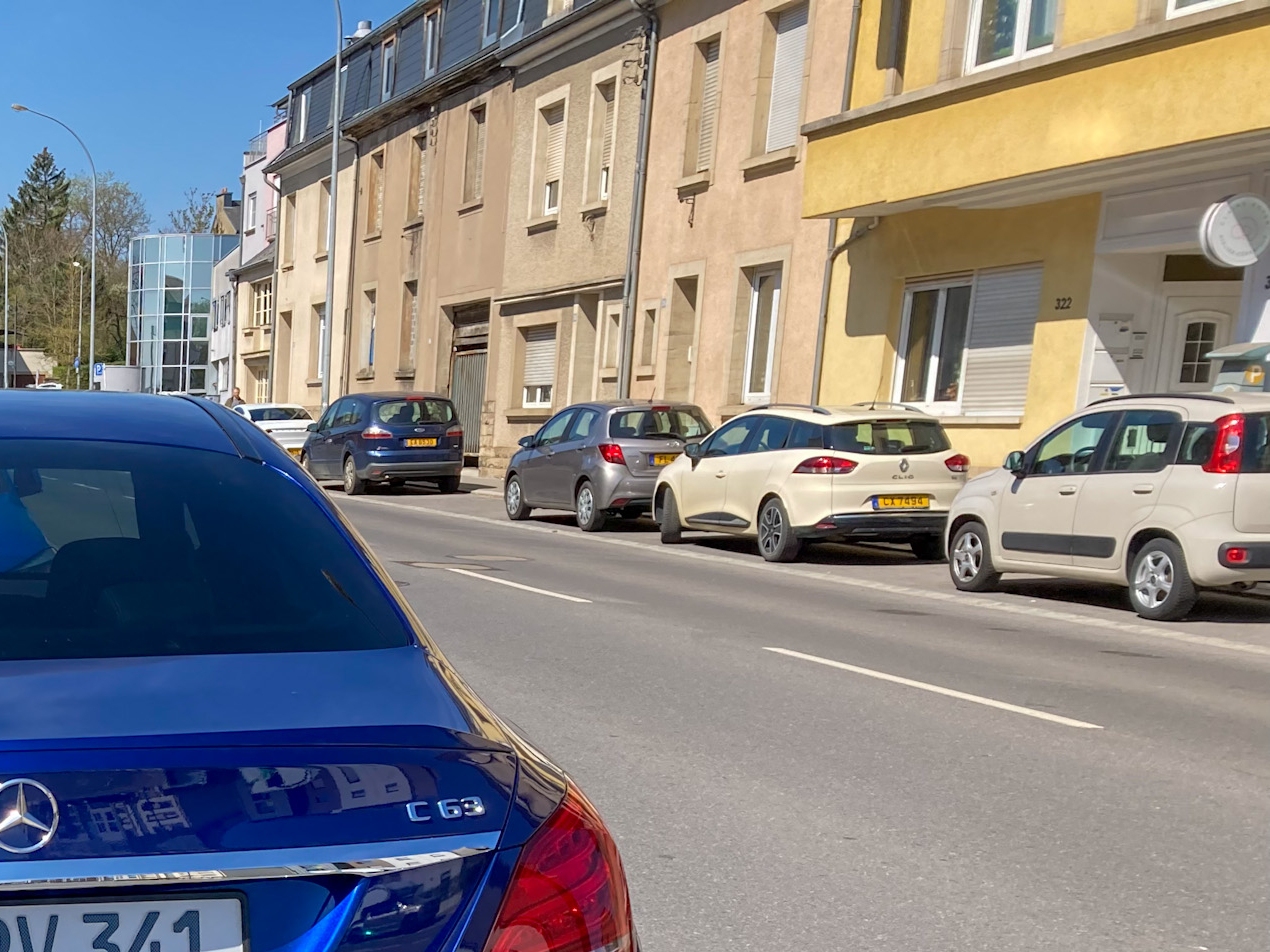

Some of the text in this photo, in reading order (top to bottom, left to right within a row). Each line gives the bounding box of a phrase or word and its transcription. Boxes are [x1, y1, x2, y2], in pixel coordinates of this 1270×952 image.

[1055, 297, 1073, 310] 322
[406, 796, 486, 822] C 63
